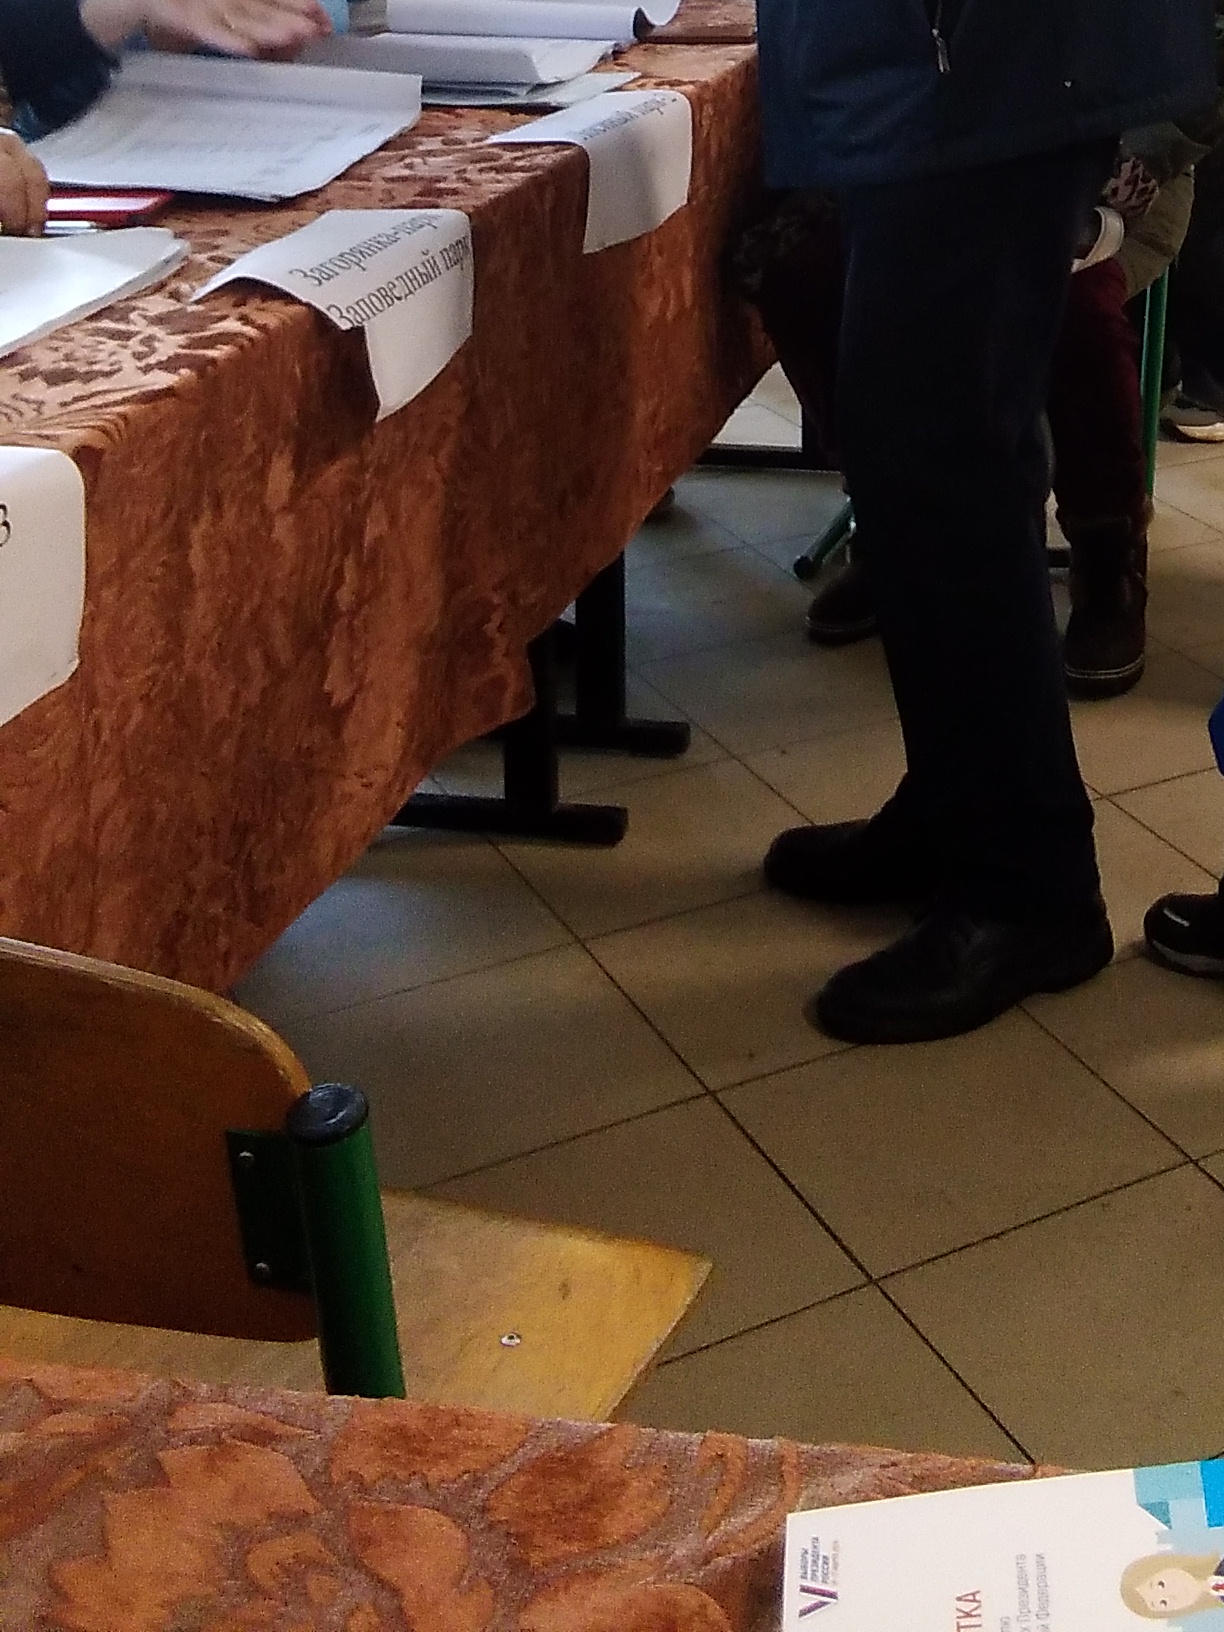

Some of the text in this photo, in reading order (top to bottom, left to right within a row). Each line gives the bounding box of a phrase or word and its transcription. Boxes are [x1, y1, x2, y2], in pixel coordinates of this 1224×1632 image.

[326, 248, 442, 327] Заповедный
[955, 1590, 982, 1632] ТКА
[1014, 1554, 1031, 1623] Президента
[1036, 1553, 1050, 1620] Федерации
